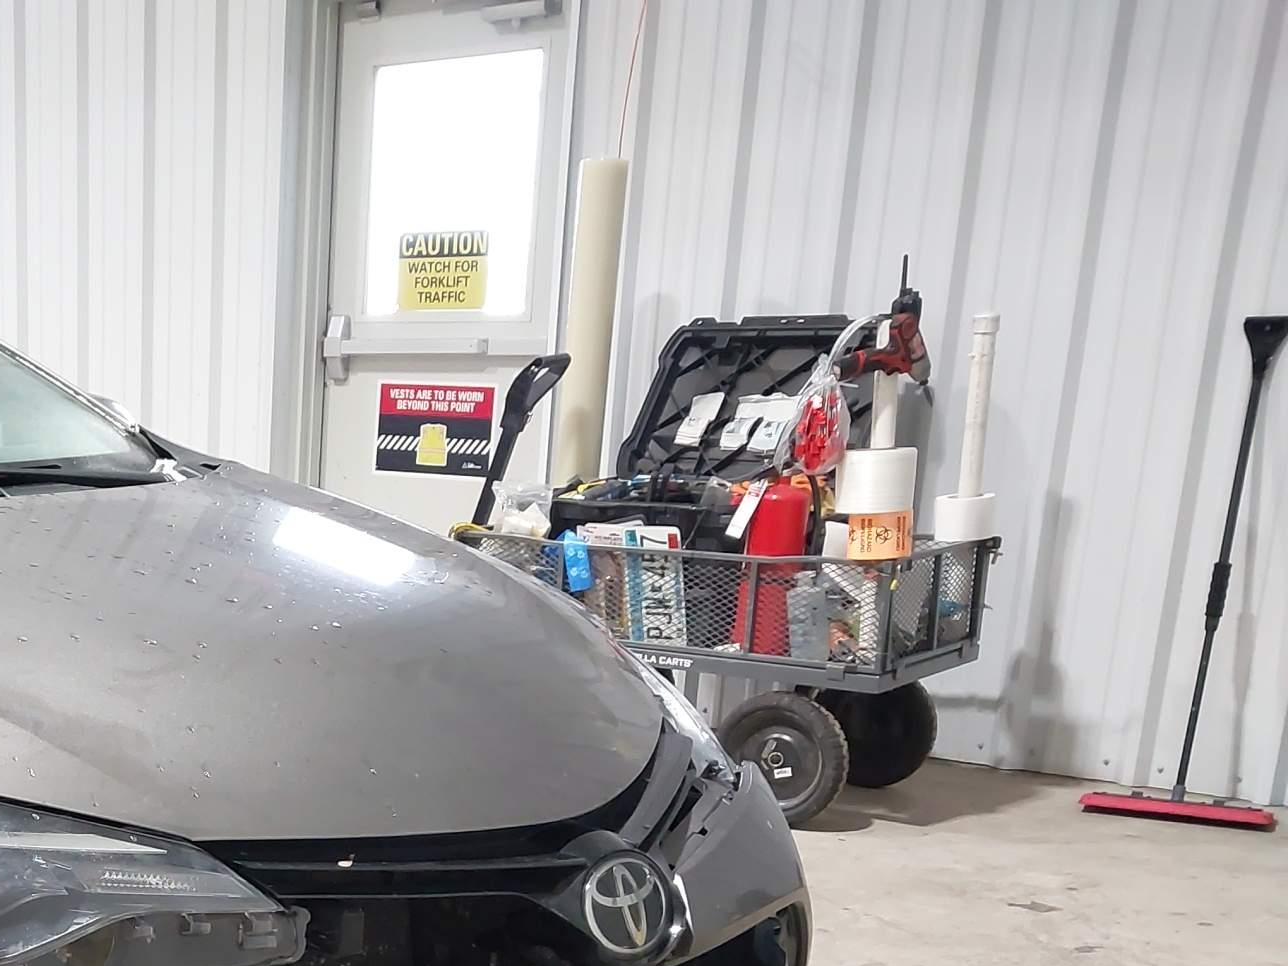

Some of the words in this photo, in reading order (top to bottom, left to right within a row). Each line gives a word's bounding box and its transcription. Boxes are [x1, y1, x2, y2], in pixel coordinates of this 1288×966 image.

[402, 231, 488, 256] CAUTION
[408, 261, 451, 273] WATCH
[454, 260, 479, 272] FOR
[414, 276, 471, 288] FORKLIFT
[417, 291, 466, 303] TRAFFIC
[390, 388, 415, 399] VESTS
[416, 389, 432, 400] ARE
[433, 390, 445, 400] TO
[446, 390, 456, 401] BE
[458, 391, 485, 402] WORN
[397, 400, 429, 411] BEYOND
[431, 401, 449, 411] THIS
[450, 402, 476, 413] POINT
[658, 655, 693, 668] CARTS
